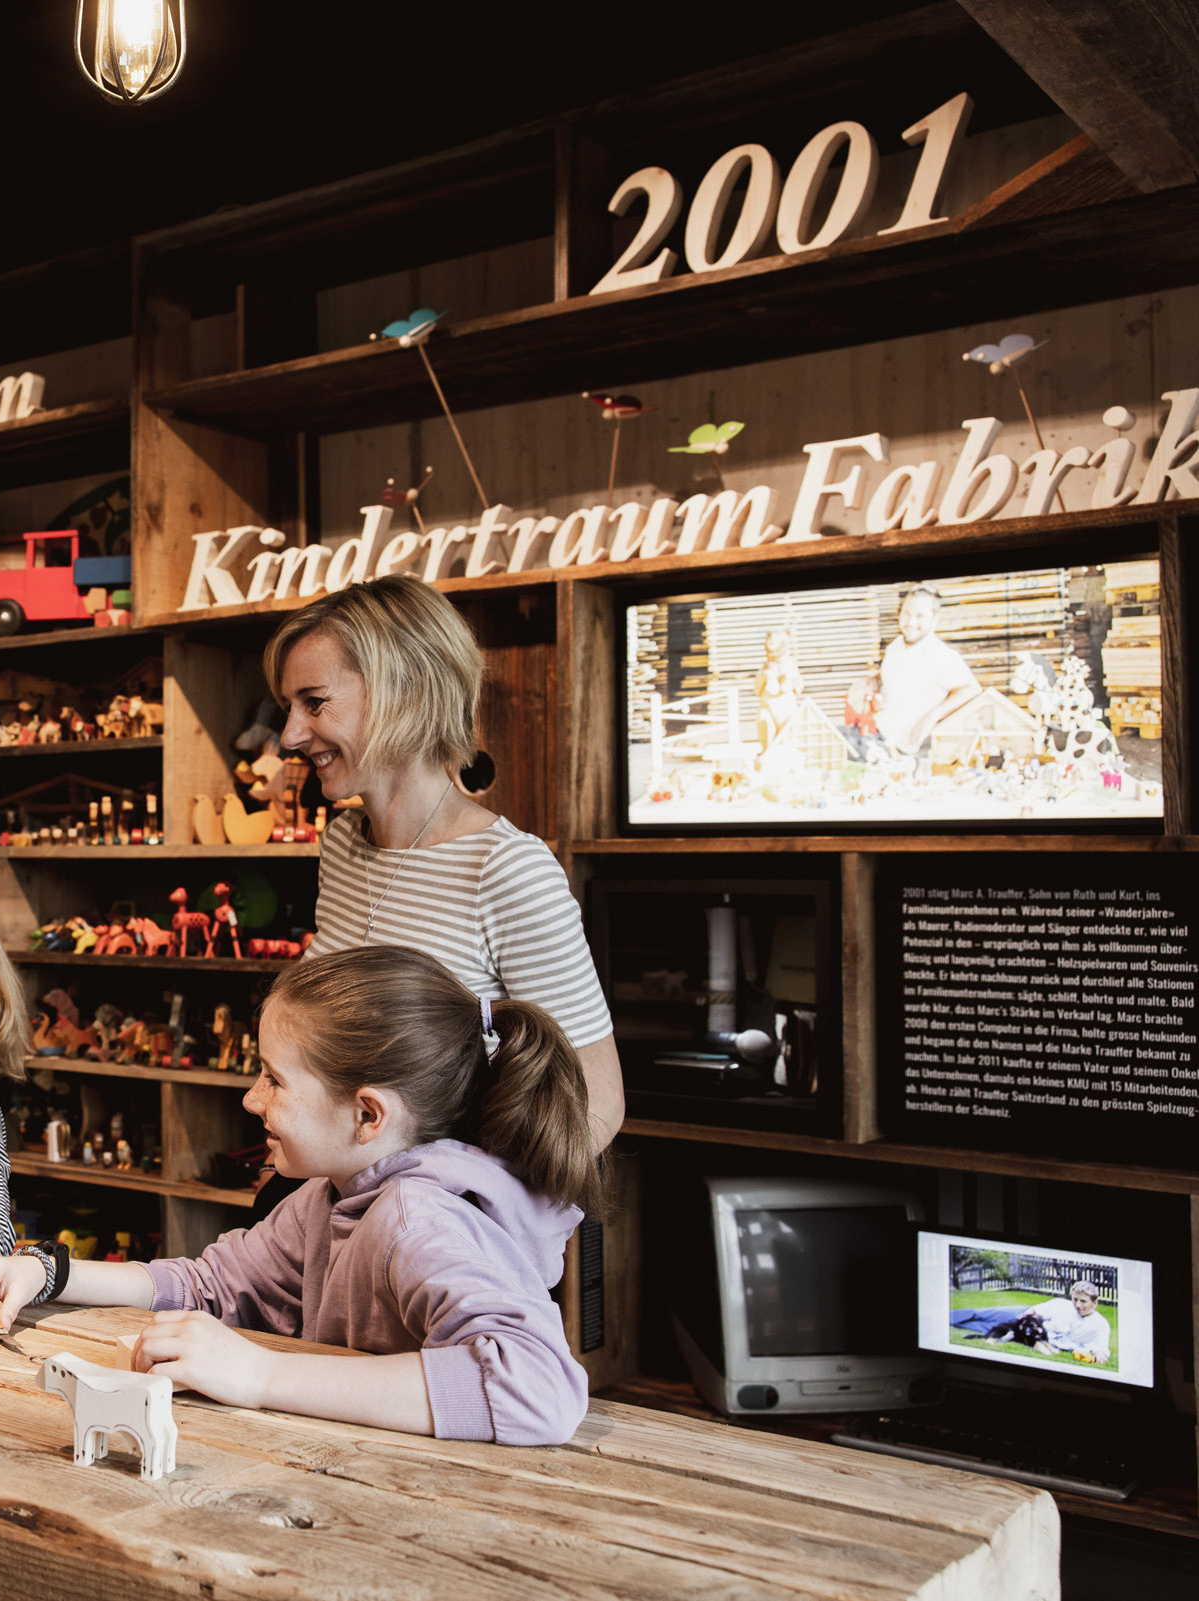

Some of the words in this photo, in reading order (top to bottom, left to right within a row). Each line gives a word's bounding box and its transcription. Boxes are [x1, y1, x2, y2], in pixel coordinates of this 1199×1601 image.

[588, 91, 974, 296] 2001
[903, 887, 924, 897] 2001
[928, 889, 949, 900] stieg
[951, 888, 973, 898] Marc
[1028, 888, 1051, 899] Sohn
[1054, 891, 1070, 899] von
[1073, 889, 1095, 899] Ruth
[1098, 889, 1116, 899] und
[1146, 890, 1160, 900] ins
[902, 903, 999, 915] Familienunternehmen
[1021, 905, 1062, 916] Während
[1066, 907, 1095, 917] seiner
[903, 920, 916, 930] als
[954, 920, 1025, 932] Radiomoderator
[1028, 922, 1045, 933] und
[1048, 922, 1080, 935] Sänger
[1083, 924, 1131, 935] entdeckte
[1150, 925, 1166, 935] wie
[1170, 925, 1187, 936] viel
[903, 935, 942, 947] Potenzial
[944, 938, 953, 947] in
[955, 938, 972, 948] den
[983, 938, 1040, 952] ursprünglich
[1042, 942, 1059, 950] von
[1062, 940, 1079, 950] ihm
[1082, 941, 1096, 951] als
[1098, 941, 1157, 953] vollkommen
[903, 952, 931, 965] flüssig
[933, 954, 949, 964] und
[951, 954, 995, 967] langweilig
[997, 955, 1046, 967] erachteten
[1057, 957, 1127, 971] Holzspielwaren
[1130, 959, 1148, 970] und
[1150, 960, 1198, 972] Souvenirs
[939, 970, 948, 980] Er
[950, 970, 978, 981] kehrte
[1030, 973, 1060, 984] zurück
[1062, 974, 1080, 985] und
[1082, 975, 1124, 987] durchlief
[1127, 977, 1144, 988] alle
[1147, 977, 1194, 989] Stationen
[904, 985, 915, 995] im
[1082, 992, 1113, 1004] bohrte
[1116, 994, 1134, 1005] und
[1172, 996, 1194, 1007] Bald
[904, 1002, 930, 1012] wurde
[954, 1004, 974, 1014] dass
[1010, 1006, 1040, 1017] Stärke
[1042, 1007, 1054, 1018] im
[1057, 1008, 1094, 1020] Verkauf
[1117, 1011, 1141, 1023] Marc
[1144, 1012, 1182, 1025] brachte
[930, 1019, 946, 1029] den
[948, 1021, 975, 1031] ersten
[977, 1021, 1020, 1035] Computer
[1023, 1024, 1032, 1034] in
[1034, 1024, 1048, 1035] die
[1082, 1027, 1105, 1038] holte
[1108, 1031, 1139, 1042] grosse
[1142, 1030, 1196, 1043] Neukunden
[904, 1034, 920, 1044] und
[923, 1035, 954, 1048] begann
[956, 1037, 970, 1047] die
[972, 1038, 989, 1048] den
[992, 1039, 1023, 1050] Namen
[1025, 1041, 1042, 1052] und
[1045, 1042, 1059, 1053] die
[1062, 1043, 1091, 1055] Marke
[1095, 1044, 1132, 1057] Trauffer
[1136, 1047, 1175, 1060] bekannt
[1179, 1052, 1190, 1061] zu
[943, 1053, 954, 1062] Im
[957, 1054, 975, 1064] Jahr
[978, 1054, 999, 1066] 2011
[1002, 1056, 1032, 1068] kaufte
[1034, 1061, 1044, 1069] er
[1047, 1060, 1080, 1071] seinem
[1083, 1061, 1109, 1073] Vater
[1112, 1063, 1130, 1075] und
[1133, 1065, 1168, 1077] seinem
[905, 1067, 920, 1077] das
[983, 1072, 1014, 1084] damals
[1017, 1075, 1030, 1085] ein
[1033, 1075, 1064, 1087] kleines
[1067, 1077, 1088, 1089] KMU
[1091, 1080, 1107, 1090] mit
[1110, 1080, 1121, 1091] 15
[905, 1099, 953, 1113] herstellern
[955, 1103, 969, 1114] der
[920, 1084, 946, 1095] Heute
[949, 1086, 970, 1097] zählt
[974, 1087, 1008, 1100] Trauffer
[1012, 1090, 1066, 1104] Switzerland
[1068, 1097, 1078, 1106] zu
[1082, 1096, 1099, 1107] den
[1102, 1097, 1143, 1113] grössten
